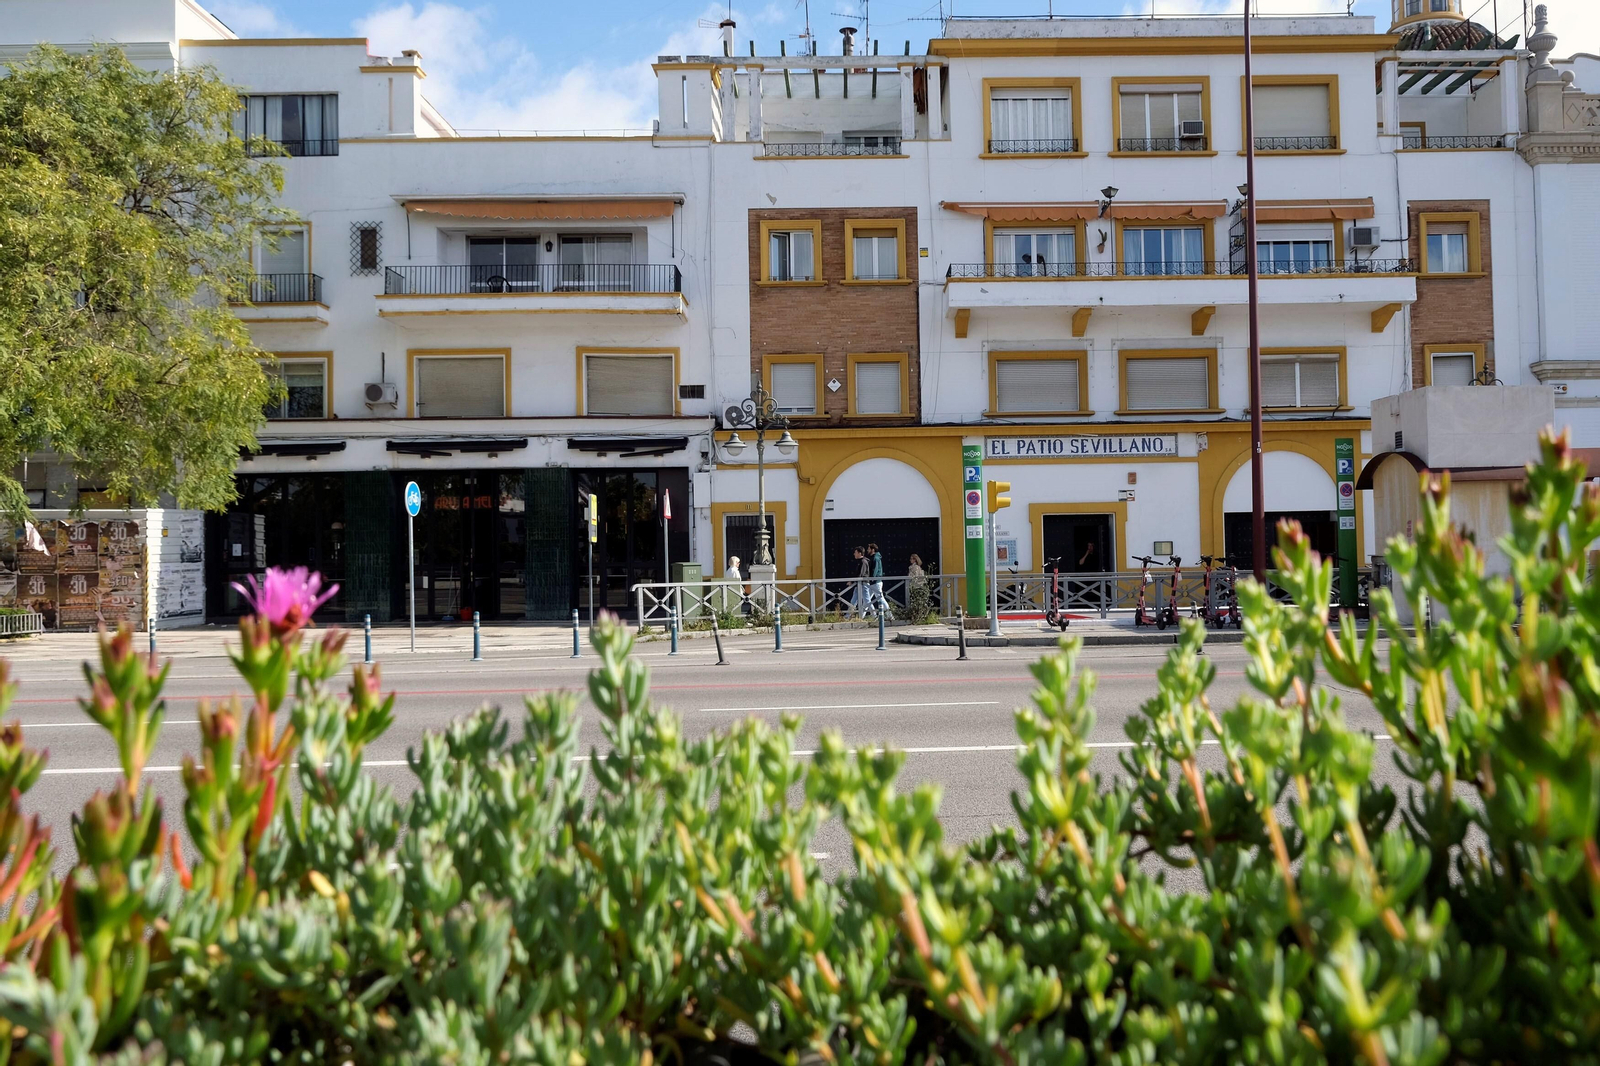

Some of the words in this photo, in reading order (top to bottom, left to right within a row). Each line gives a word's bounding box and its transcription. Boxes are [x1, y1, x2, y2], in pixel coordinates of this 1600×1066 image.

[991, 440, 1010, 455] EL
[1016, 439, 1064, 455] PATIO
[1070, 437, 1164, 454] SEVILLANO
[1339, 460, 1348, 473] P
[966, 467, 976, 481] P
[70, 527, 87, 541] 30
[110, 527, 127, 541] 30
[29, 581, 46, 595] 30
[70, 580, 87, 594] 30
